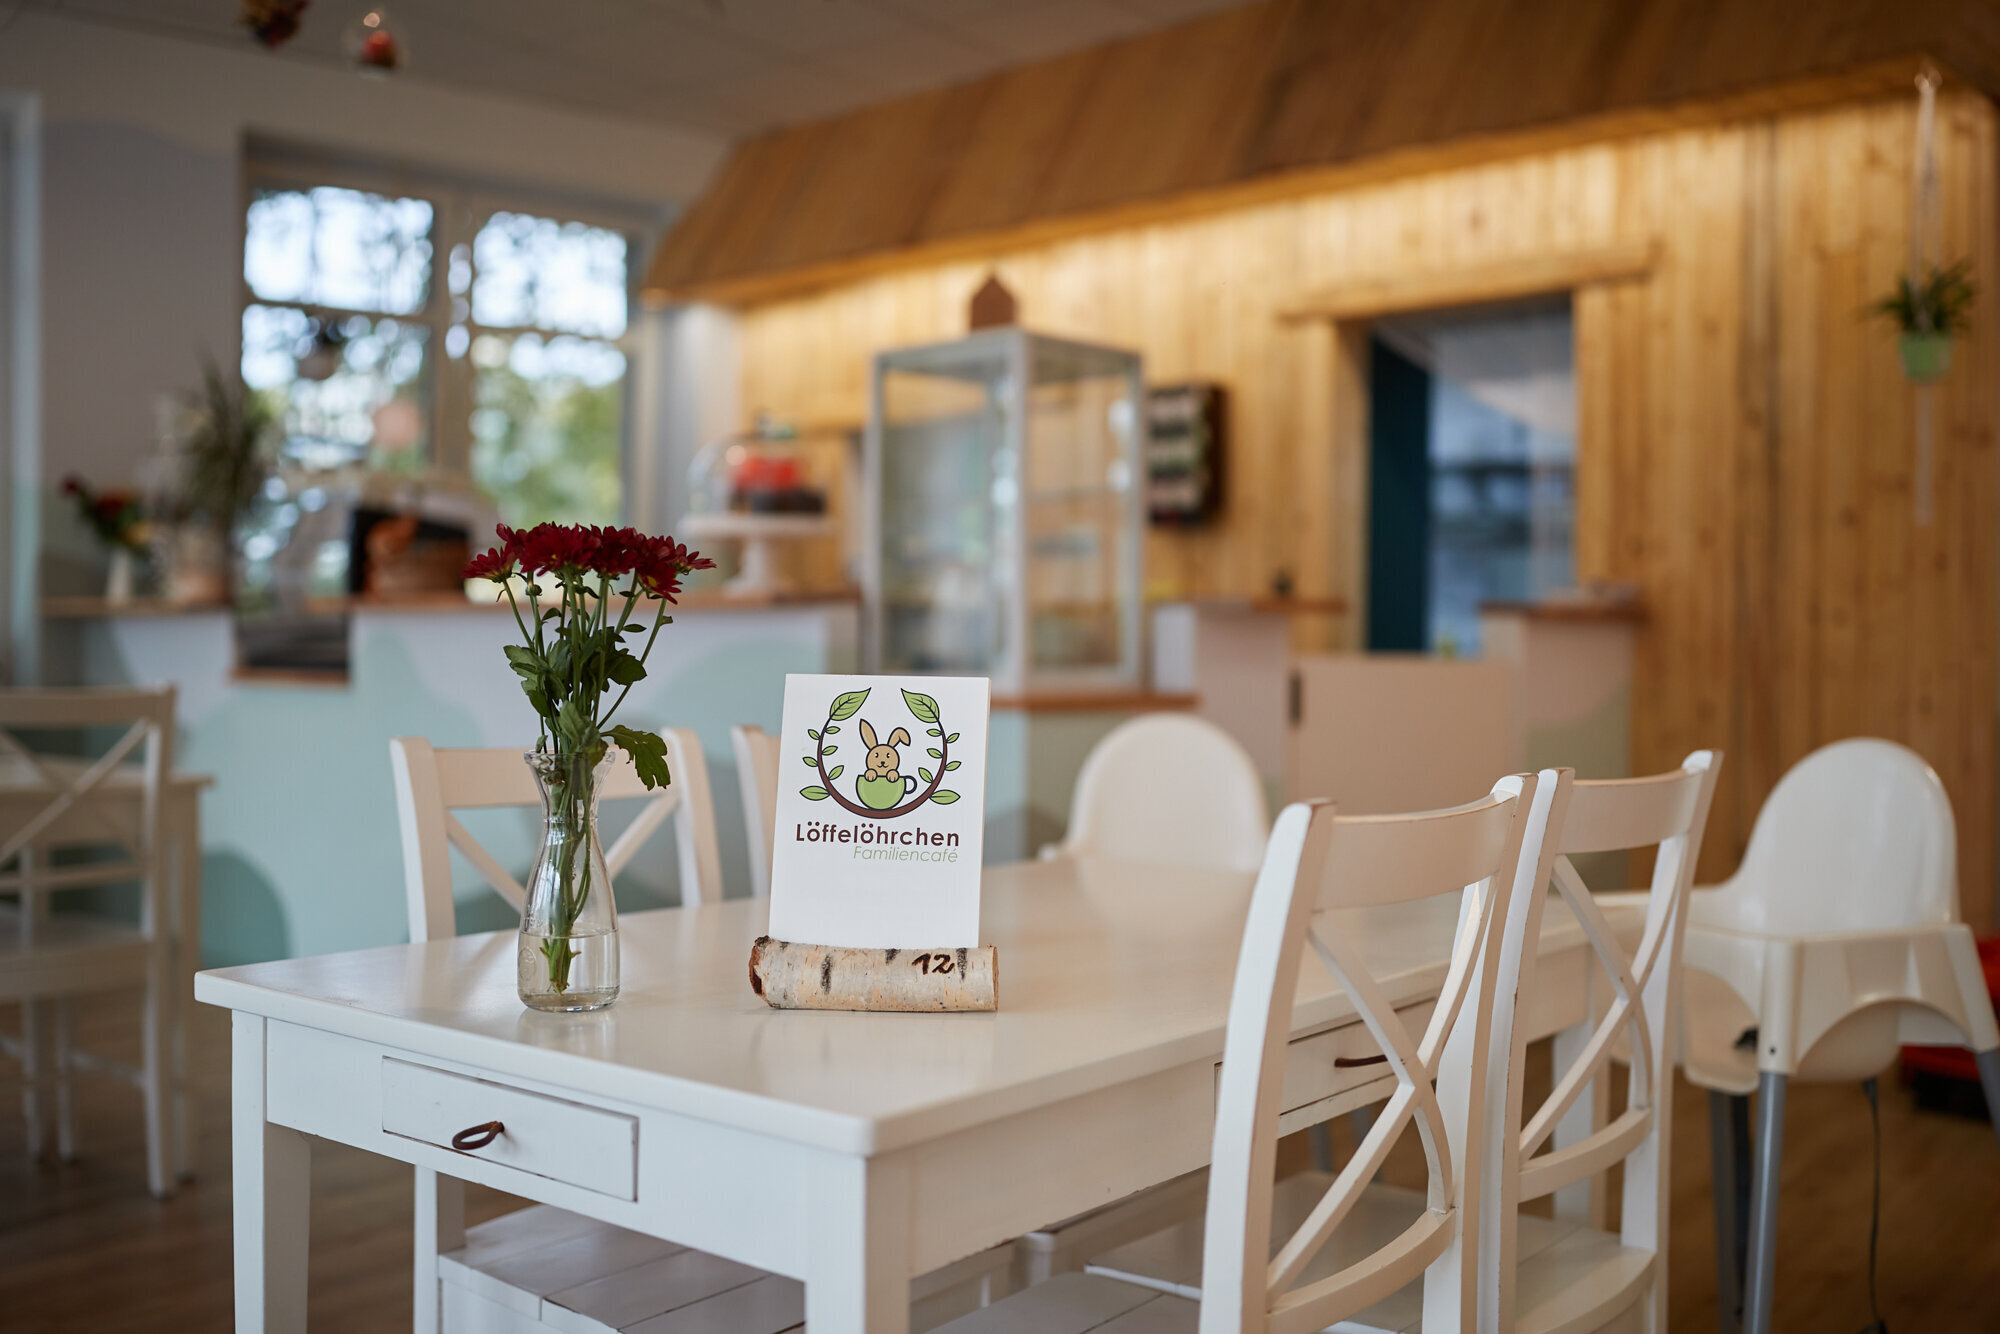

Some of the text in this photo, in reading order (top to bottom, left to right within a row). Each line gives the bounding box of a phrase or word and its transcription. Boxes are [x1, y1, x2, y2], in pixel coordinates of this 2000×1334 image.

[796, 821, 959, 847] Löffelöhrchen
[853, 845, 958, 863] Familiencafé
[911, 953, 955, 975] 12
